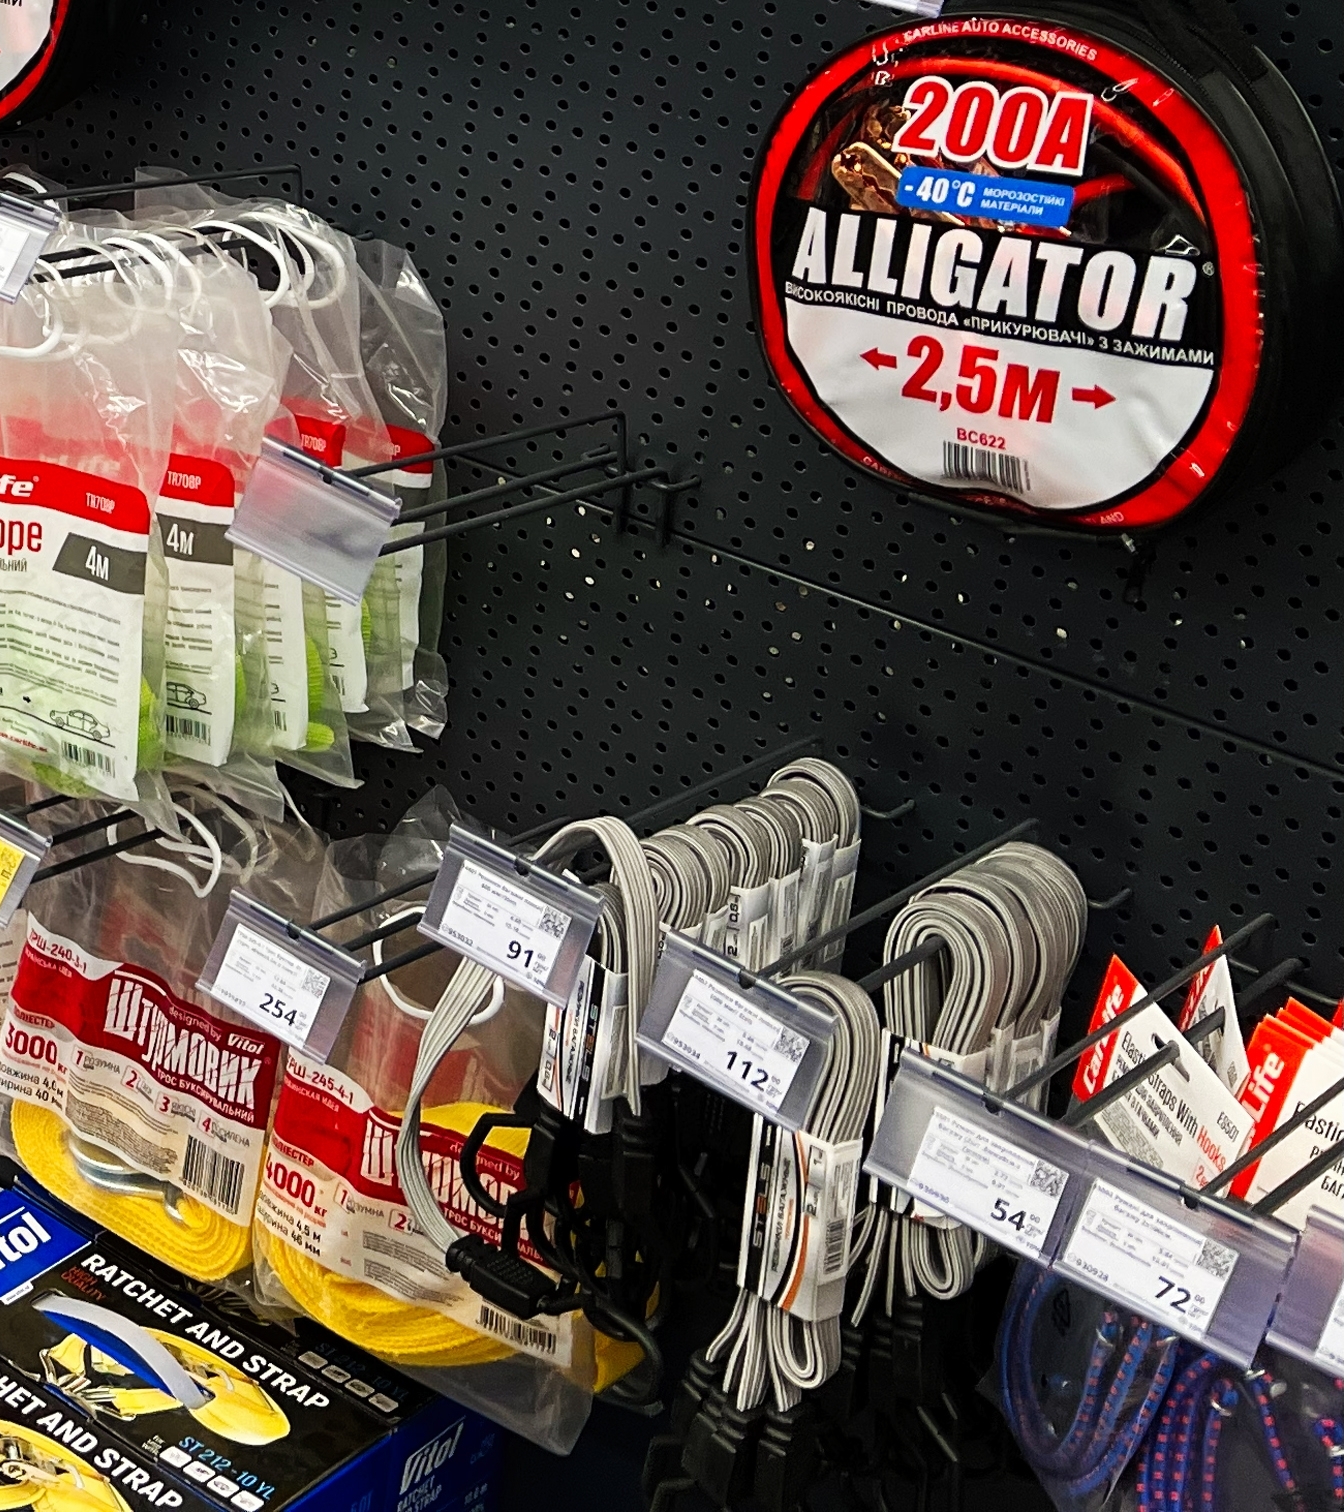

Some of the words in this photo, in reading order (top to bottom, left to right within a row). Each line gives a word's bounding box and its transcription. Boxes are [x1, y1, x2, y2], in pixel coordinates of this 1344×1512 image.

[904, 19, 960, 43] CARLINE
[962, 20, 1000, 34] AUTO
[1002, 24, 1098, 62] ACCESSORIES
[892, 75, 1093, 177] 200A
[980, 199, 1043, 216] МАТЕРІАЛИ
[792, 208, 1198, 341] ALLIGATOR
[785, 281, 880, 313] ВИСОКОЯКІСНІ
[886, 301, 960, 328] ПРОВОДА
[963, 316, 1095, 349] «ПРИКУРЮВАЧІ»
[1113, 337, 1215, 367] ЗАЖИМАМИ
[507, 940, 535, 968] 91
[168, 1006, 208, 1034] designed
[208, 1028, 222, 1042] by
[227, 1033, 266, 1055] Vitol
[259, 992, 297, 1028] 254
[104, 972, 263, 1110] ШТУРМОВИК
[156, 1069, 177, 1087] ТРОС
[727, 1050, 769, 1092] 112
[1147, 1070, 1179, 1112] Straps
[1176, 1096, 1200, 1137] With
[1196, 1125, 1227, 1174] Hooks
[990, 1198, 1026, 1232] 54
[291, 1228, 304, 1247] 46
[1155, 1276, 1191, 1314] 72
[80, 1252, 190, 1328] RATCHET
[189, 1318, 249, 1362] AND
[238, 1352, 330, 1412] STRAP
[34, 1412, 99, 1457] AND
[91, 1444, 184, 1508] STRAP
